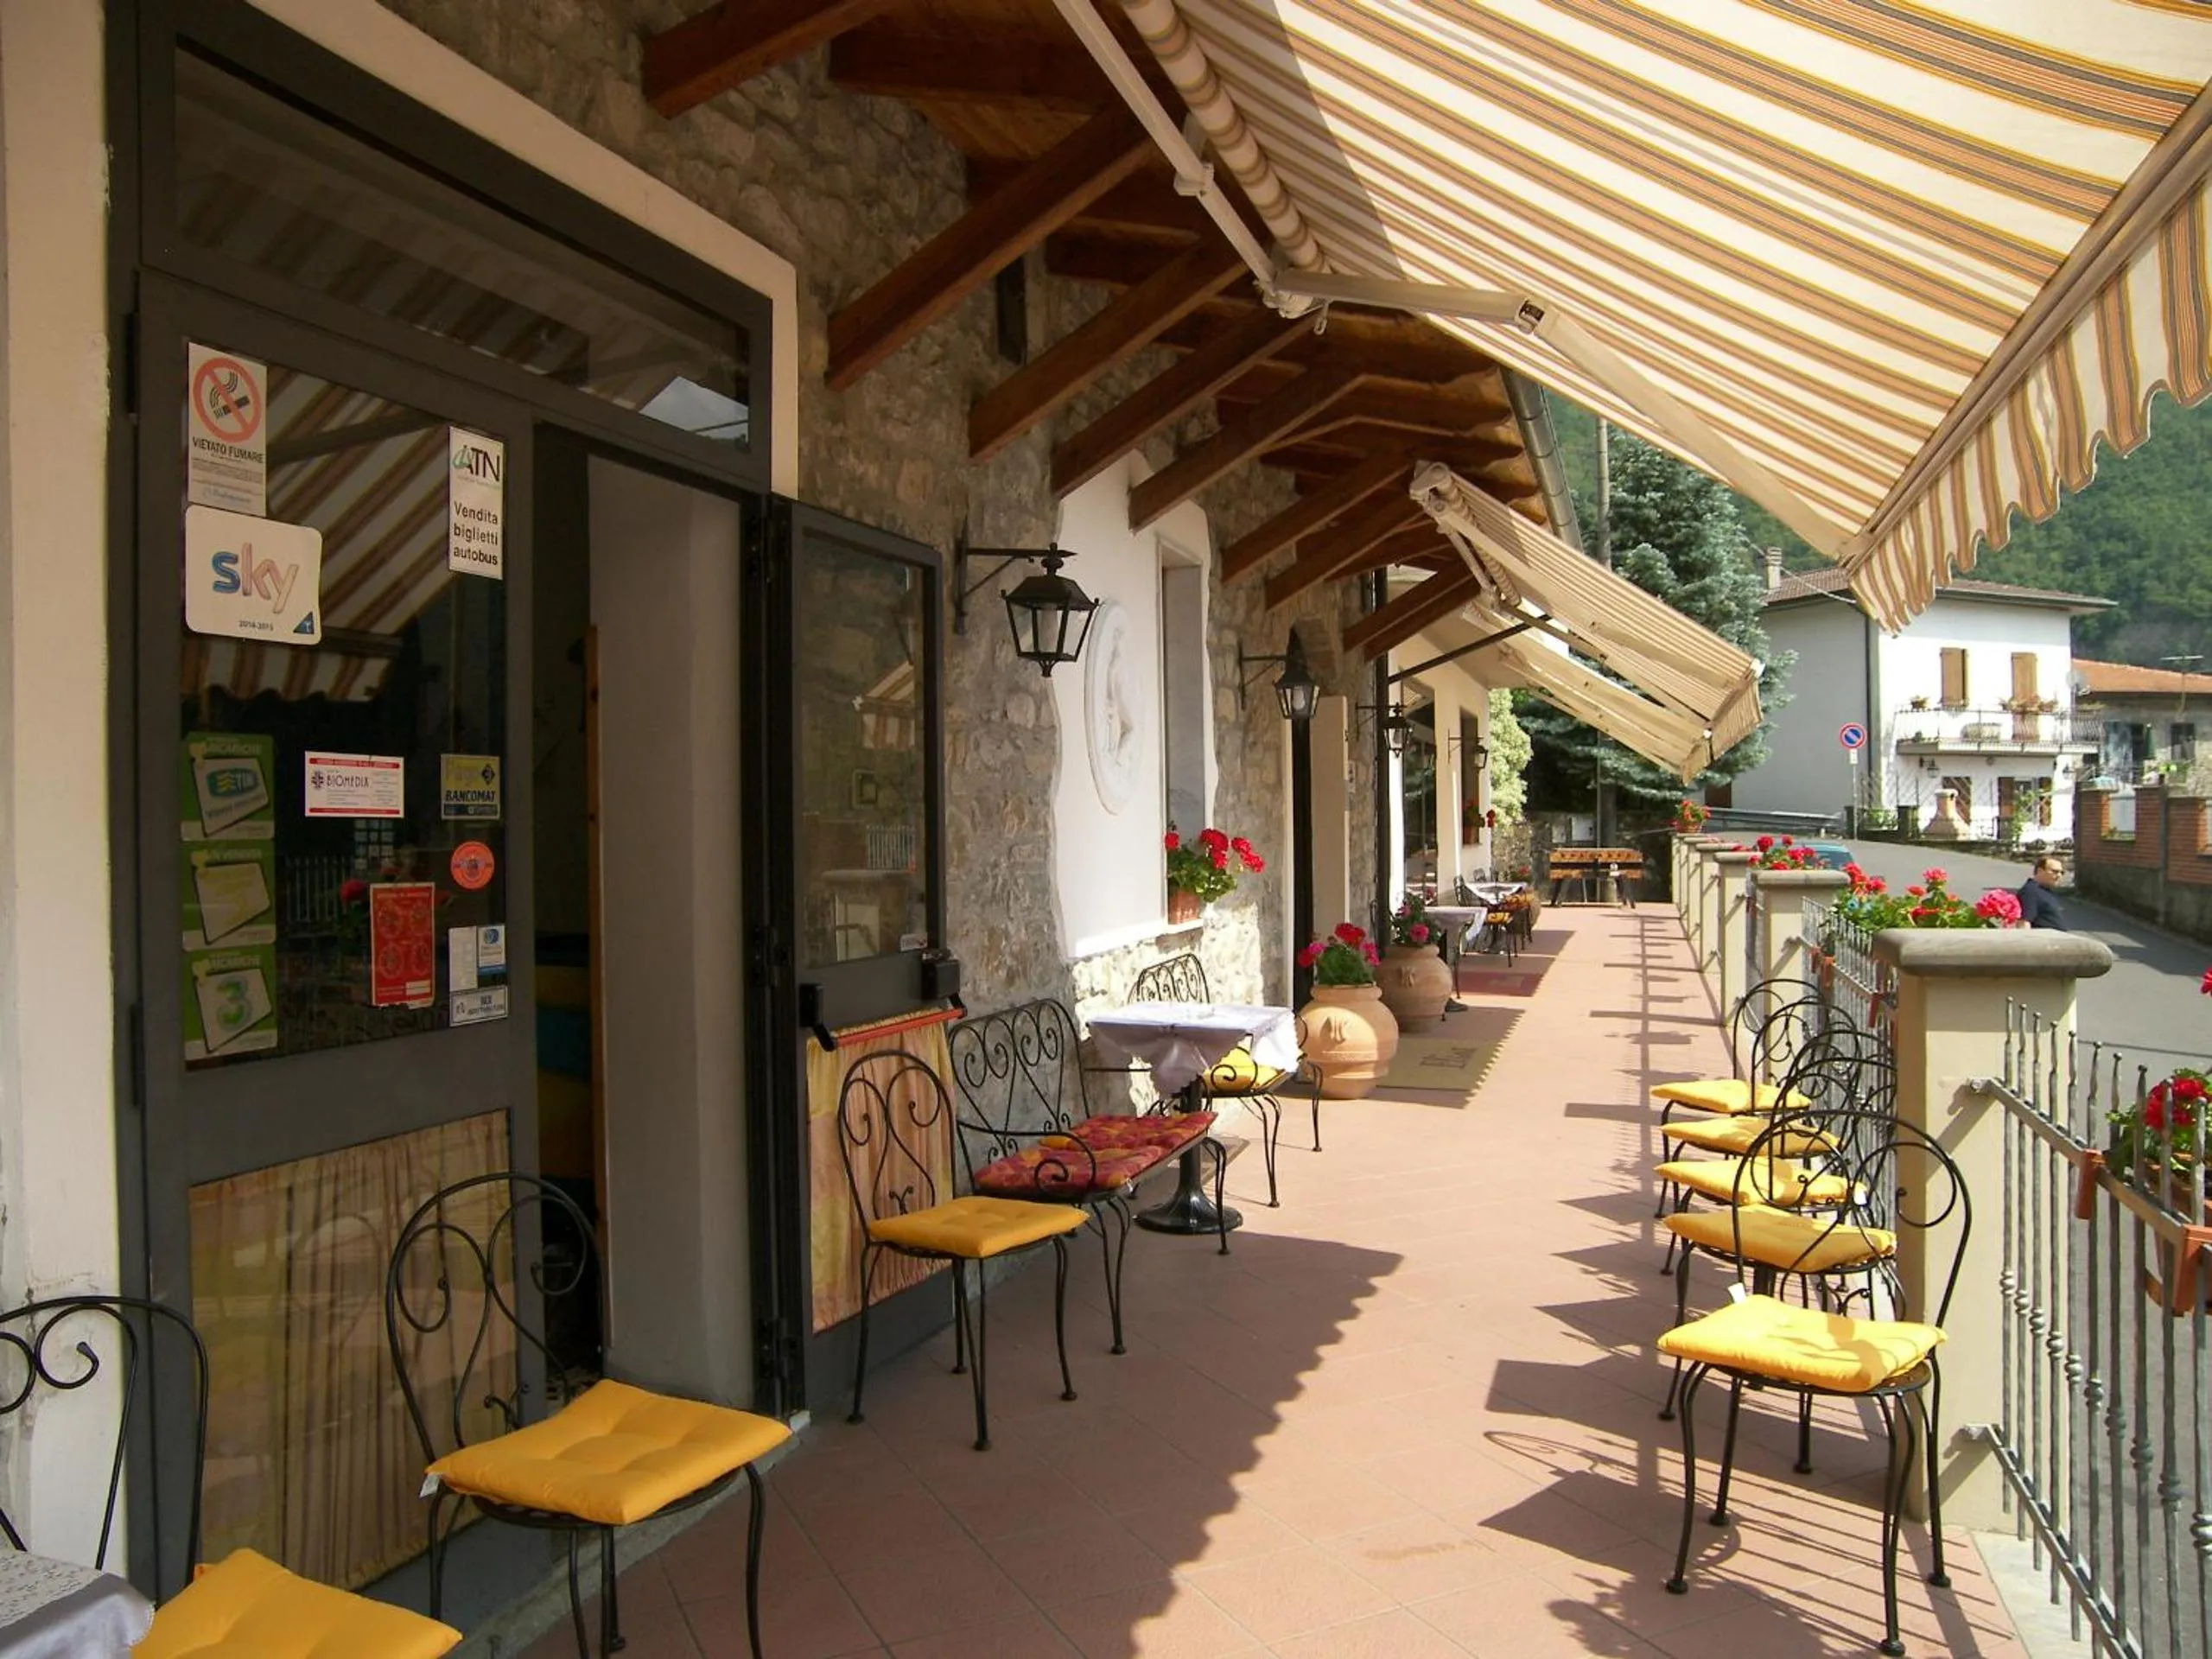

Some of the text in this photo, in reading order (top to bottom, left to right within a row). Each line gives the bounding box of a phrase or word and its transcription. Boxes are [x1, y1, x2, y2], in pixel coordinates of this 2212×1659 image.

[192, 436, 264, 464] VIETATO FUMARE
[454, 500, 498, 524] Vendita
[454, 523, 498, 546] biglietti
[454, 546, 498, 566] autobus
[211, 541, 299, 614] sky
[327, 774, 370, 788] BIOMEDIX
[445, 790, 496, 802] BANCOMAT
